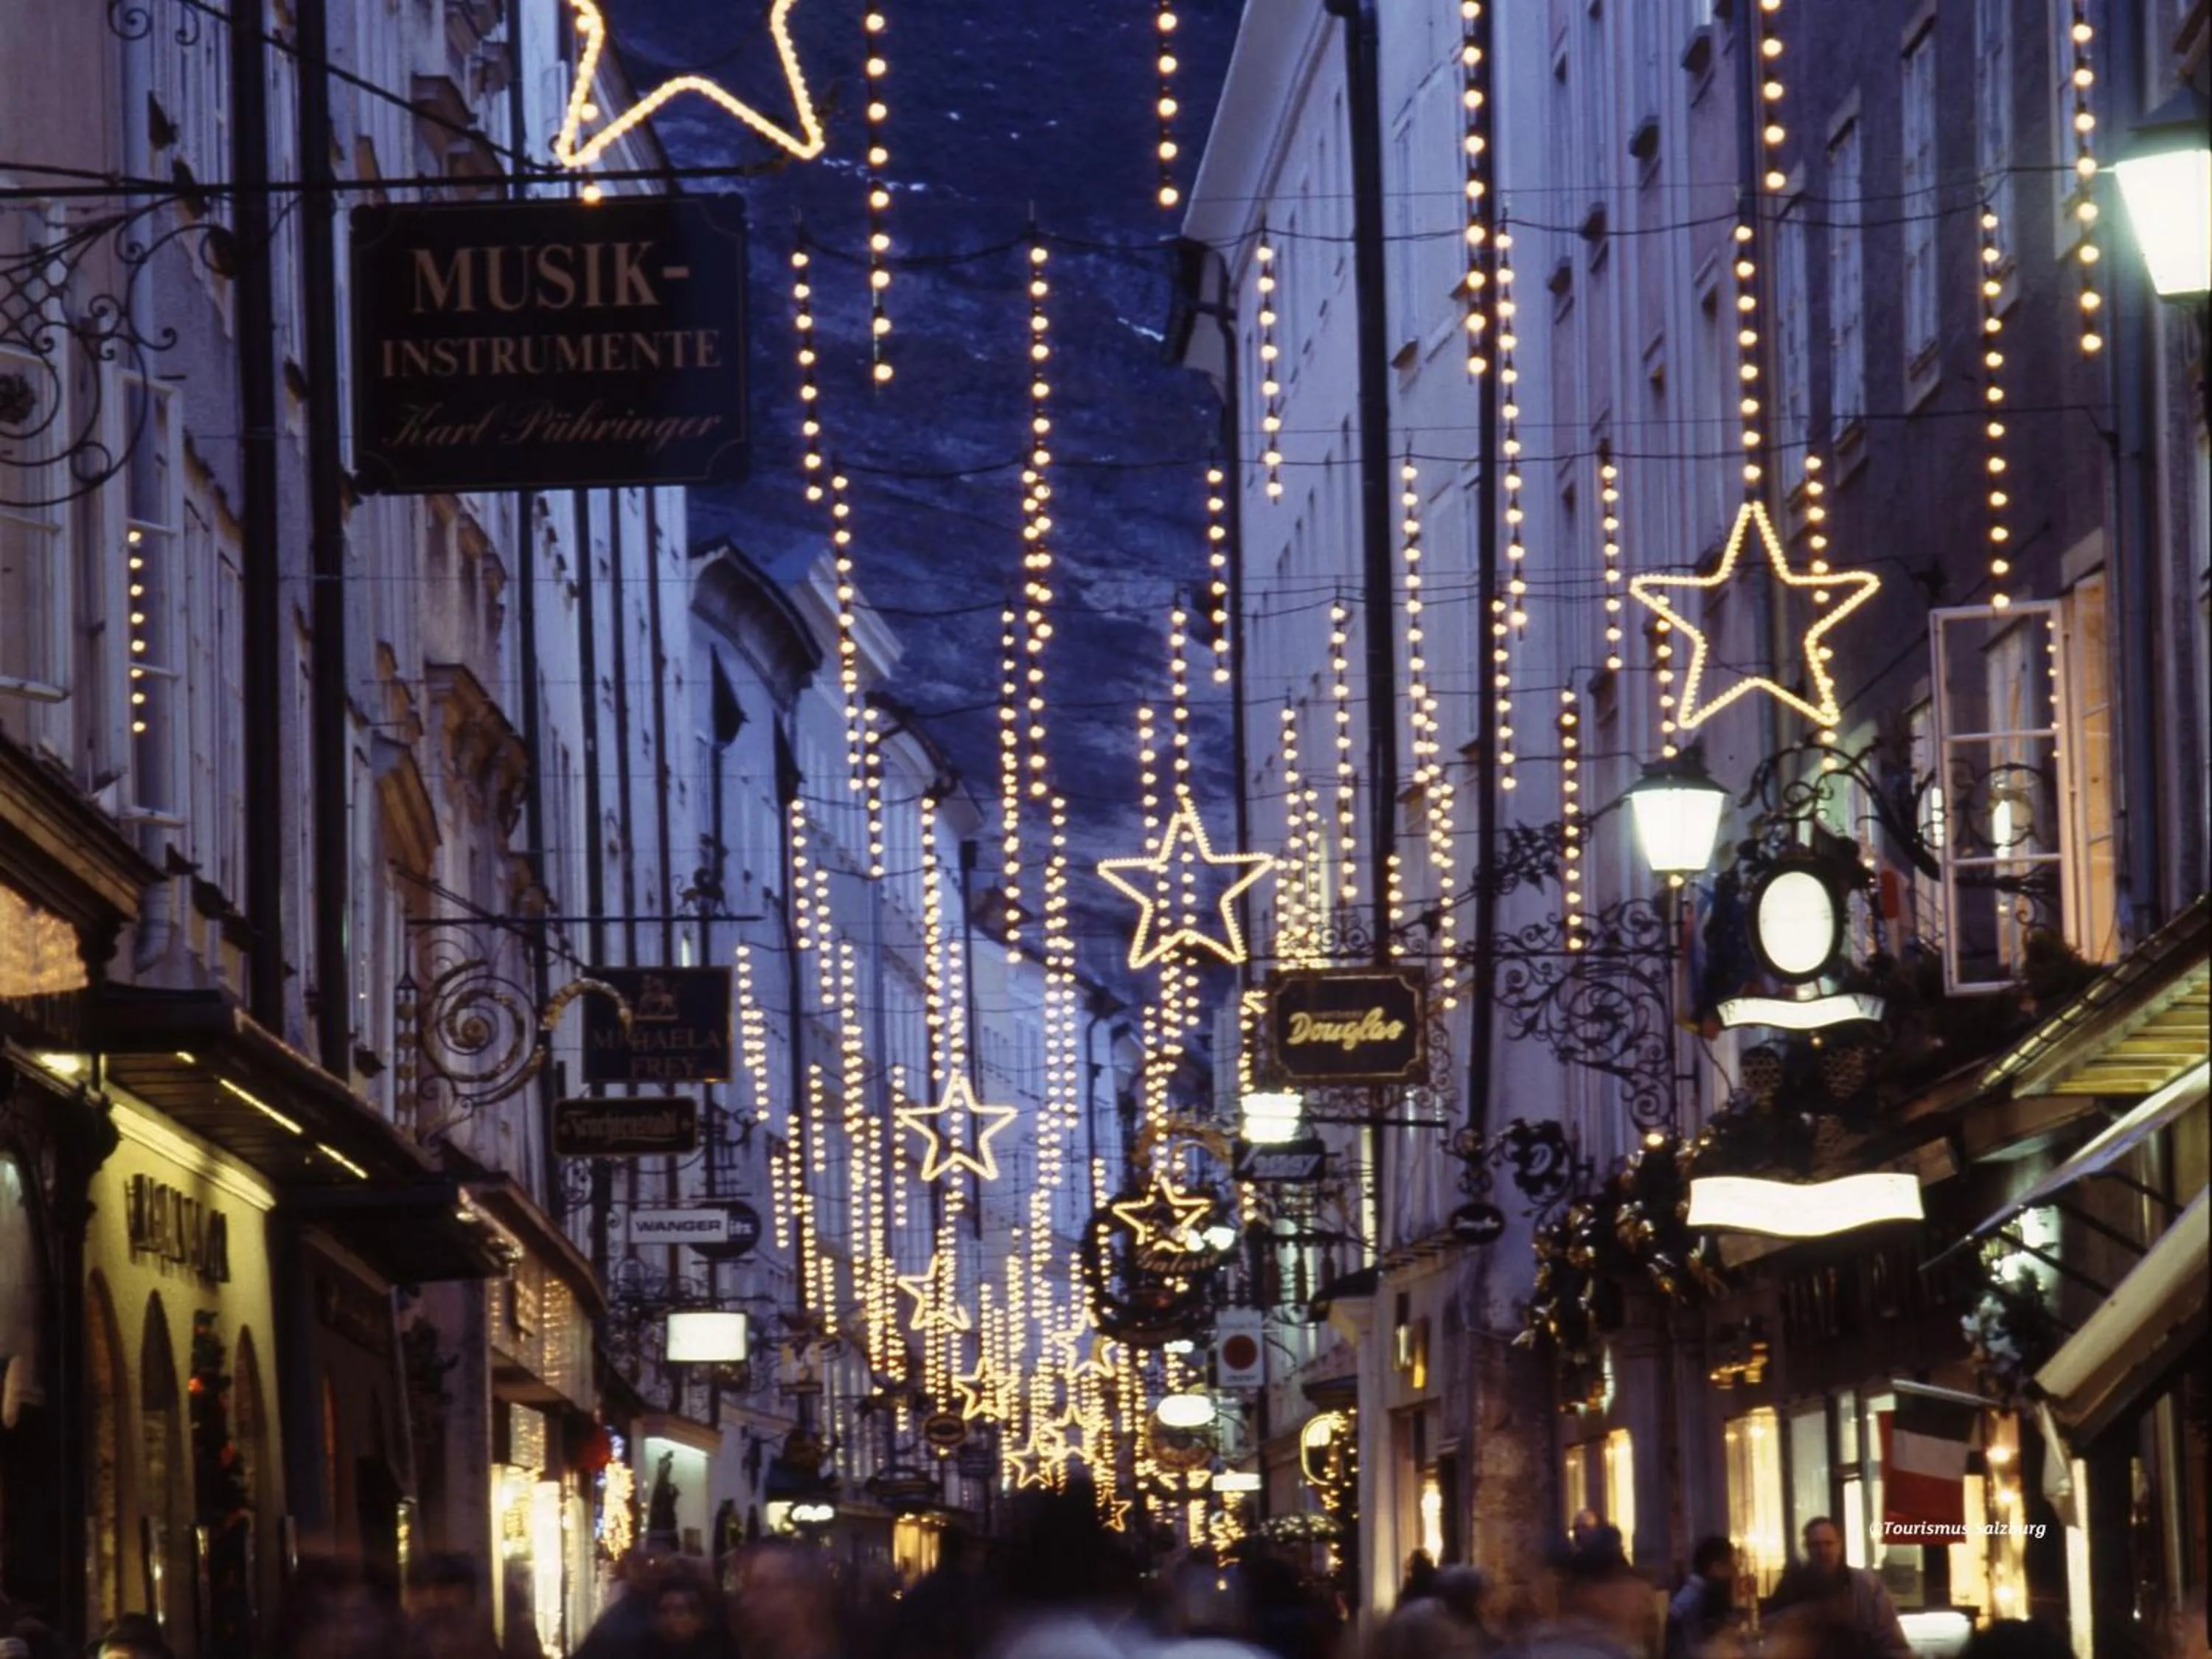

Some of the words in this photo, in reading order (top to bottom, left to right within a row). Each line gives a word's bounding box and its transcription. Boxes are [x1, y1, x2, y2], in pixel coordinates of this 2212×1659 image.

[411, 240, 690, 314] MUSIK-
[381, 329, 723, 378] INSTRUMENTE
[381, 400, 504, 448] Karl
[498, 398, 723, 454] Pühringer
[1286, 1006, 1406, 1051] Douglas
[636, 1219, 721, 1232] WANGER
